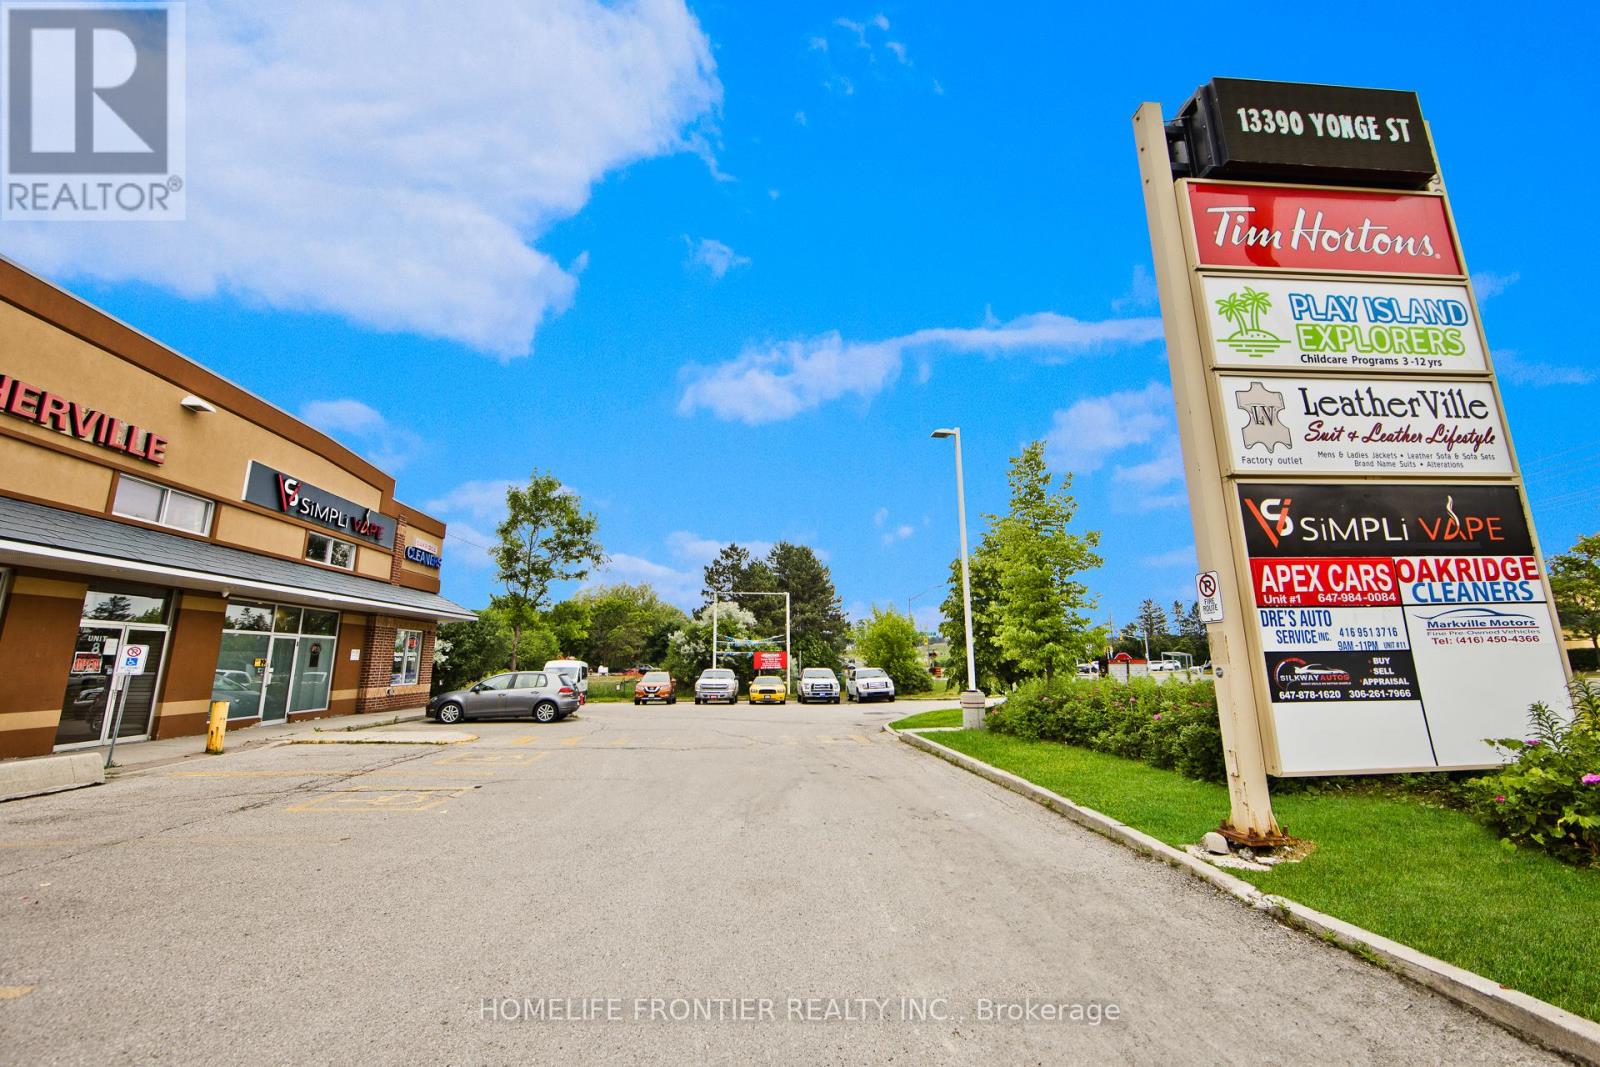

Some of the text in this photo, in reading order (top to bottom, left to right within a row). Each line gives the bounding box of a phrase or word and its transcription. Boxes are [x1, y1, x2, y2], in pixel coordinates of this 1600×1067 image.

[1237, 107, 1411, 143] 13390 YONGE ST
[1206, 206, 1436, 257] Tim Hortons
[1288, 293, 1468, 327] PLAY ISLAND
[1296, 323, 1466, 356] EXPLORERS
[1300, 354, 1348, 365] Childcare
[1351, 355, 1399, 368] Programs
[1403, 356, 1409, 366] 3
[1427, 359, 1443, 369] yrs
[1298, 386, 1490, 420] LeatherVille
[1304, 420, 1345, 443] Suit
[1361, 422, 1424, 444] Leather
[1425, 423, 1496, 453] Lifestyle
[1241, 456, 1304, 466] Factory outlet
[1317, 450, 1336, 459] Mens
[1347, 451, 1369, 460] Ladies
[1372, 452, 1398, 460] Jackets
[1406, 452, 1433, 460] Leather
[1480, 453, 1496, 461] Sets
[1354, 460, 1375, 468] Brand
[1399, 461, 1417, 469] Suits
[1426, 462, 1464, 470] Alterations
[352, 509, 385, 540] VAPE
[1418, 495, 1505, 542] VAPE
[1261, 563, 1393, 592] APEX CARS
[1397, 556, 1540, 584] OAKRIDGE
[1263, 592, 1396, 604] Unit #1 647-984-0084
[1411, 580, 1535, 603] CLEANERS
[1260, 609, 1332, 627] DRE'S AUTO
[1427, 619, 1536, 628] Markville Motors
[1276, 629, 1332, 644] SERVICE INC.
[1432, 635, 1540, 645] Tel: (416) 450-4366
[92, 642, 100, 654] 8
[1338, 641, 1353, 650] 9AM
[1320, 673, 1350, 681] AUTOS
[1279, 689, 1411, 699] 647-878-1620 306-261-7966
